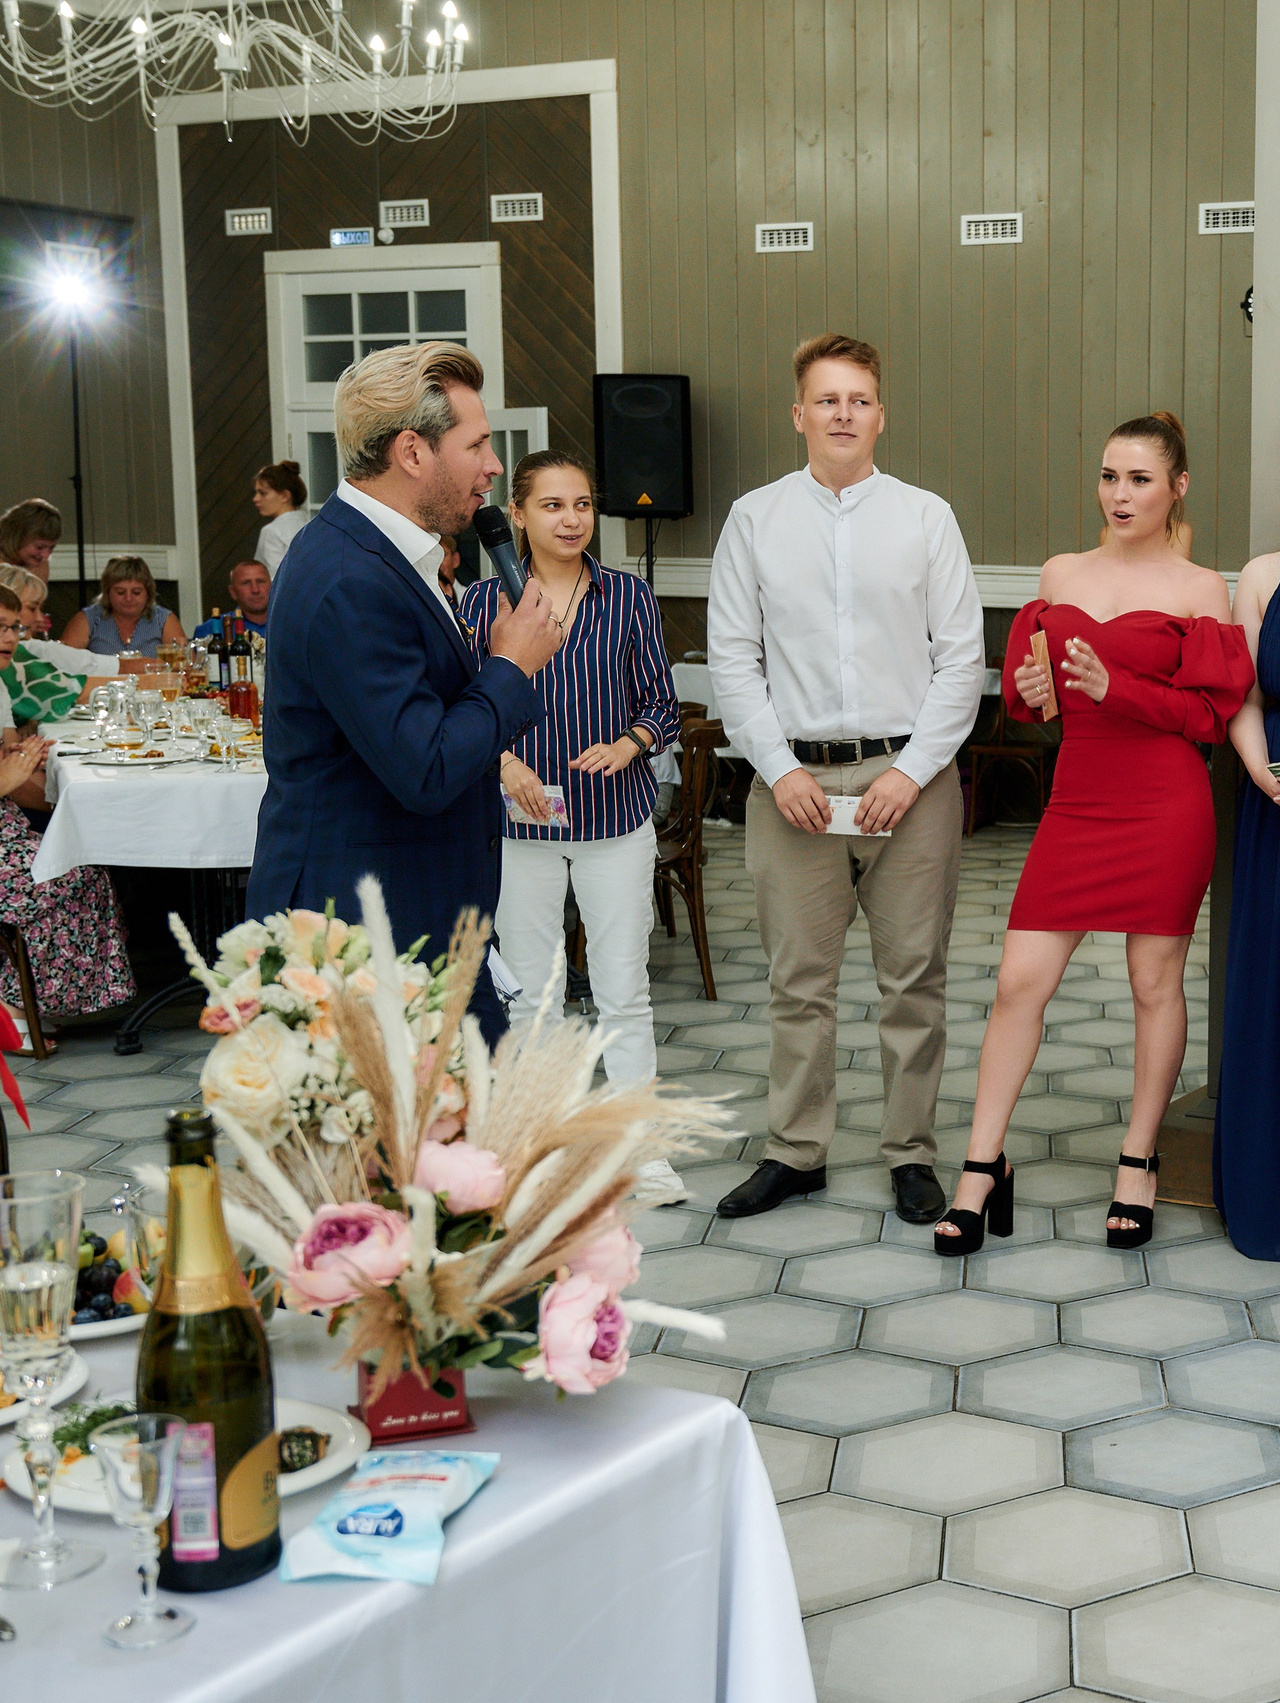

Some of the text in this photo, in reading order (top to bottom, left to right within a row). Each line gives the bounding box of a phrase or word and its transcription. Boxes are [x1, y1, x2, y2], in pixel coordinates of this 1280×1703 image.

[408, 1414, 418, 1422] to
[442, 1410, 460, 1420] you
[346, 1516, 401, 1535] AURA
